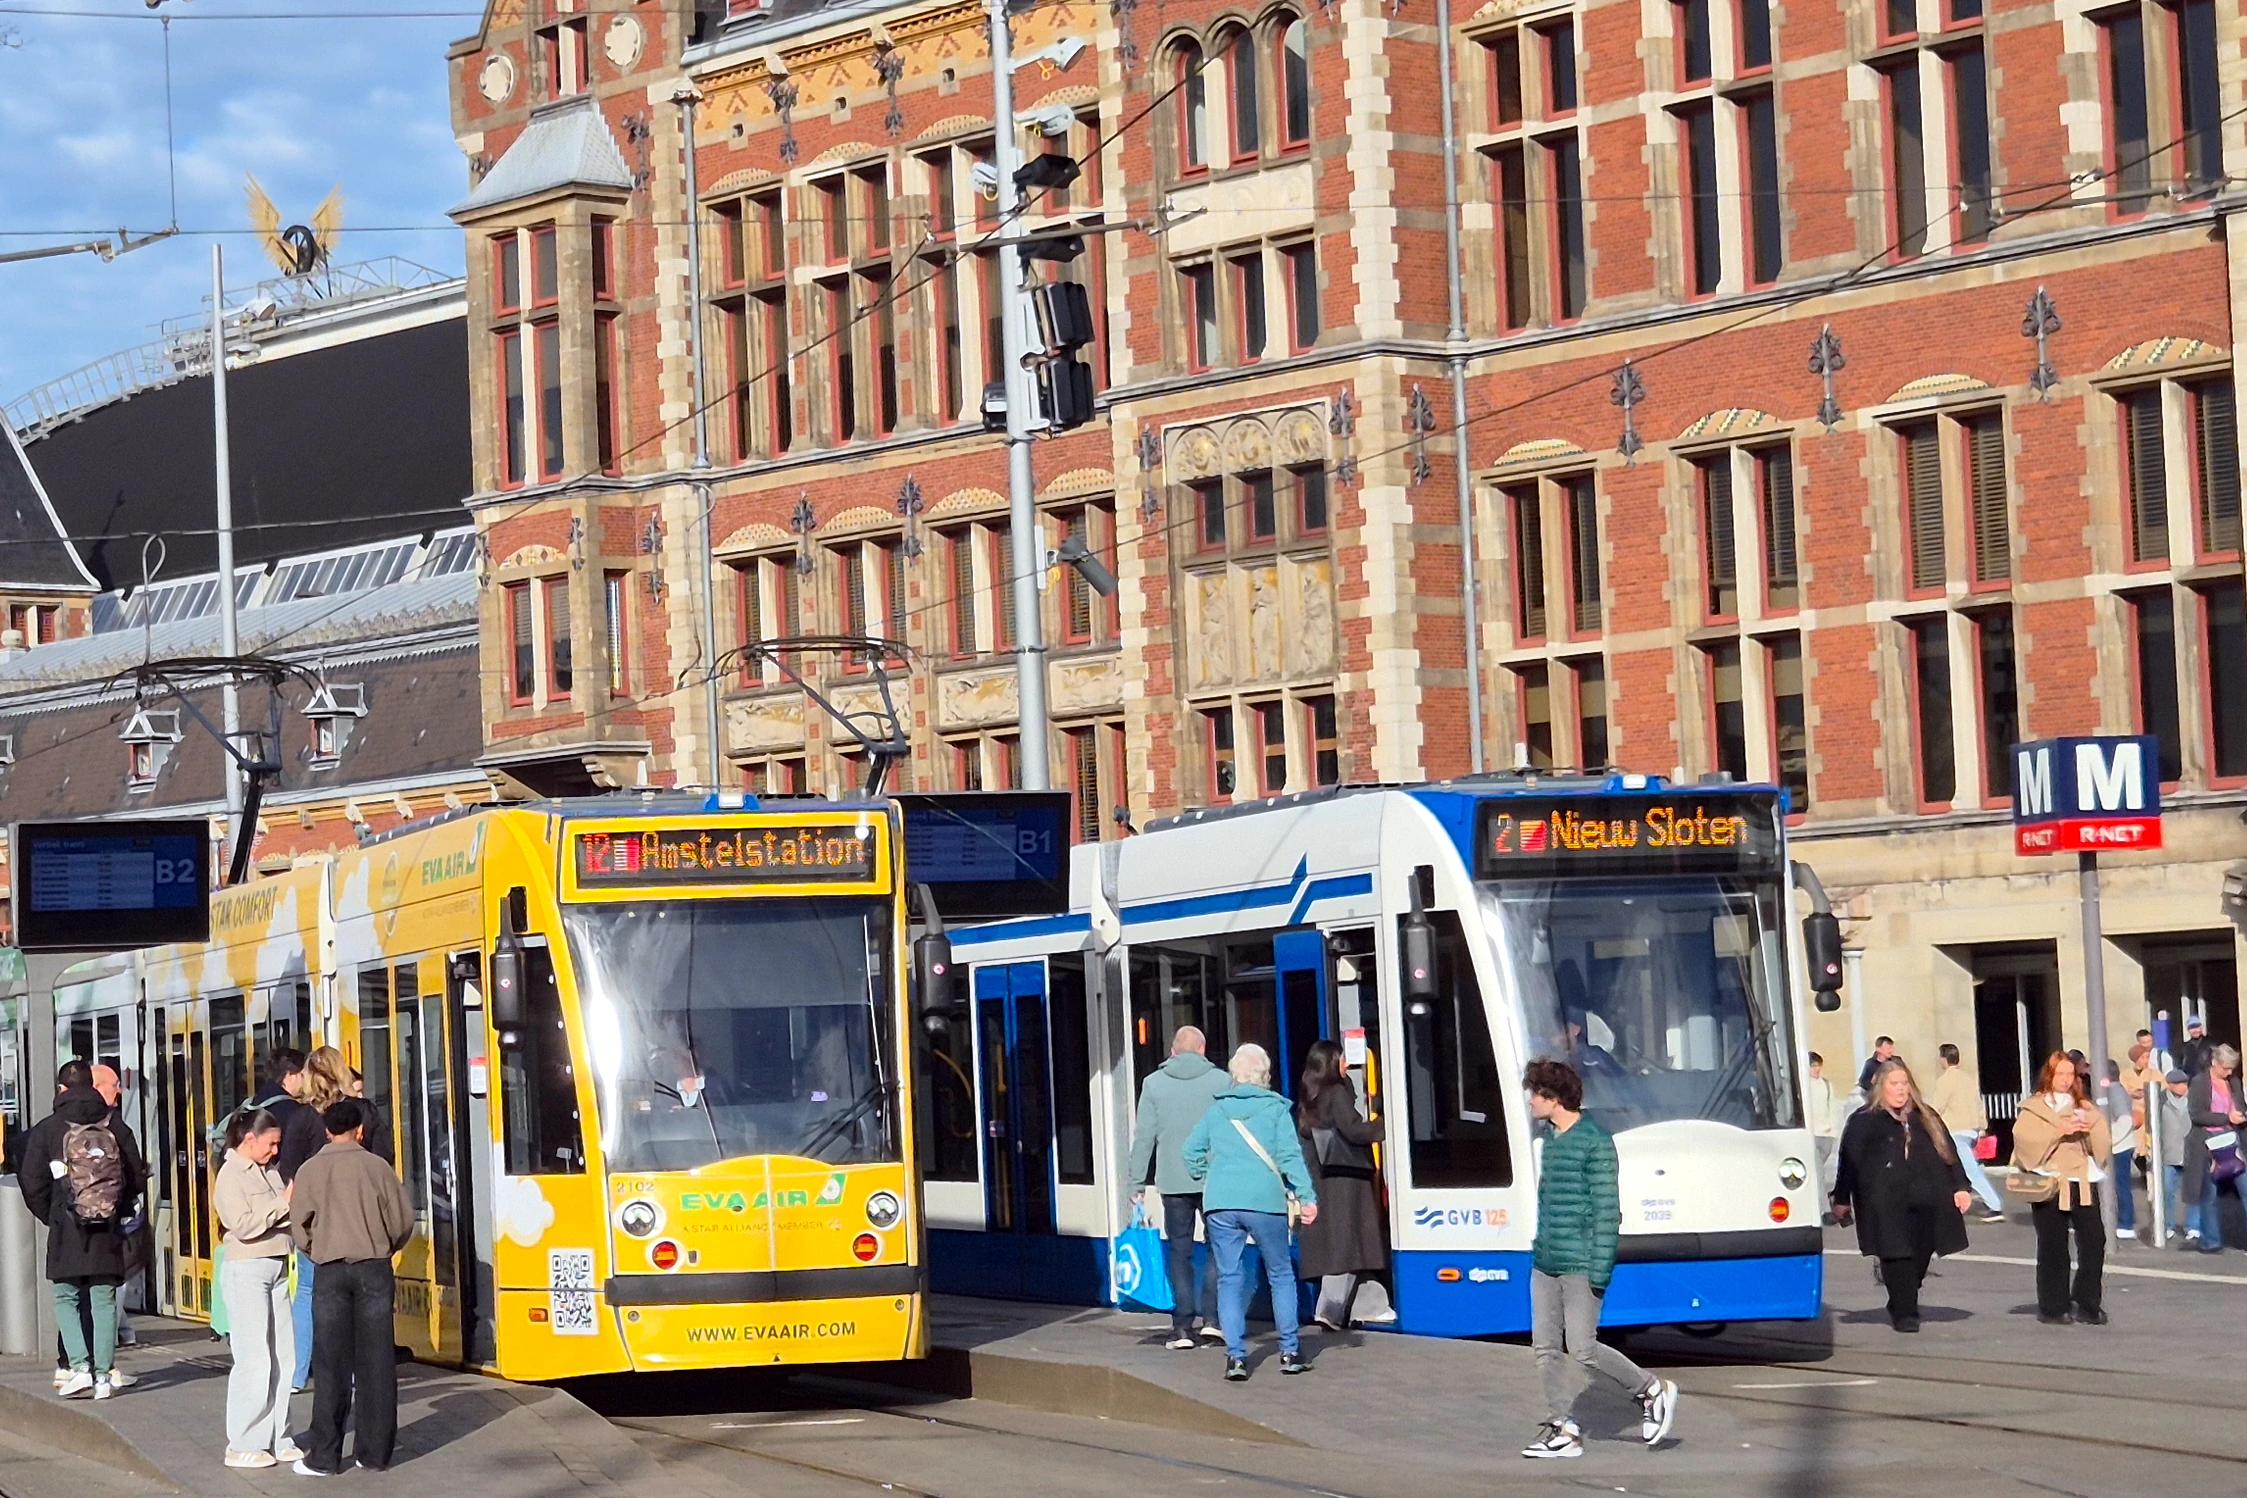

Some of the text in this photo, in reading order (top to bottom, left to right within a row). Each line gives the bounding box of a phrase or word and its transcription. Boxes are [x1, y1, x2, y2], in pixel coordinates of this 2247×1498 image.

[2018, 747, 2052, 816] M
[2075, 742, 2143, 811] M
[1018, 829, 1052, 855] B1
[1494, 806, 1748, 853] 2 Nieuw Sloten
[641, 829, 866, 870] Amstelstation
[156, 859, 196, 885] B2
[421, 851, 465, 885] EVA AIR
[210, 886, 278, 934] STAR COMFORT
[616, 1180, 655, 1194] 2102
[680, 1190, 807, 1210] EVA AIR
[691, 1224, 719, 1233] STAR
[1447, 1208, 1507, 1226] GVB 125
[687, 1321, 856, 1342] WWW.EVAAIR.COM
